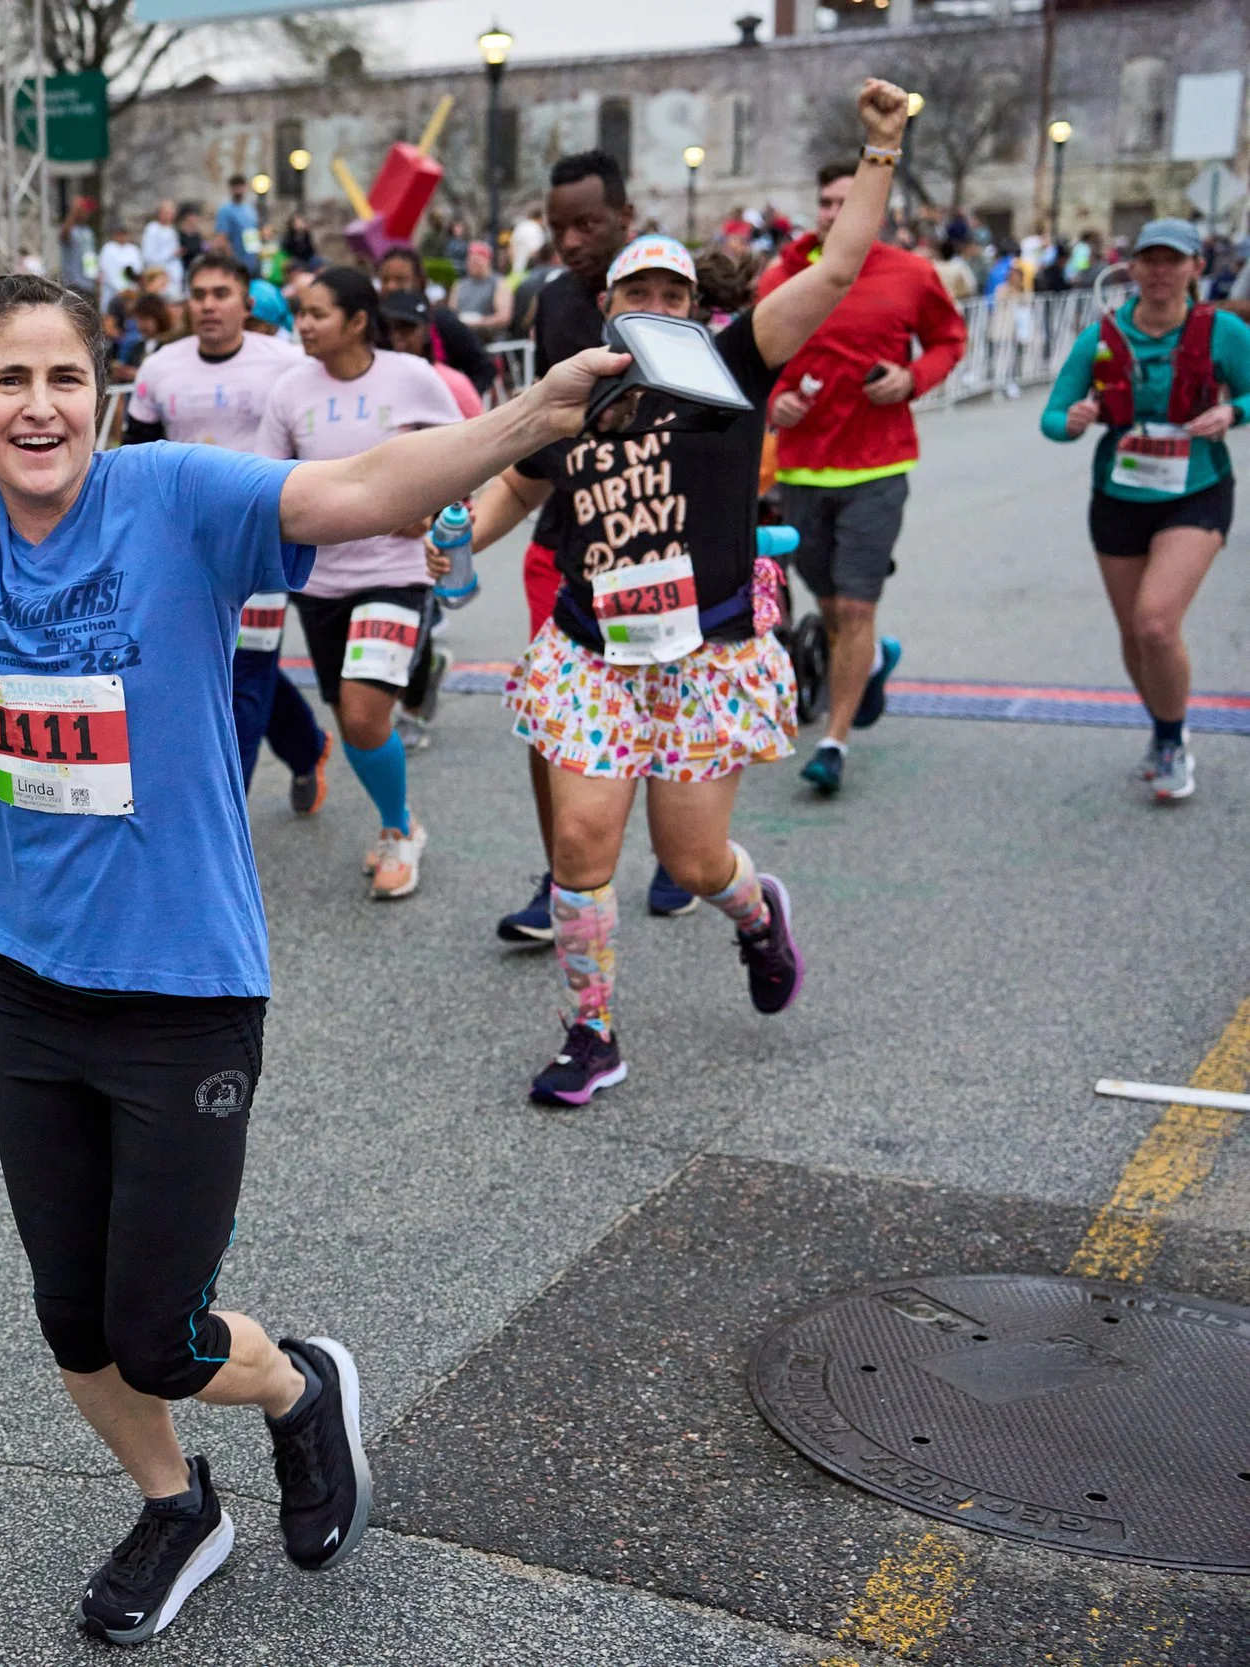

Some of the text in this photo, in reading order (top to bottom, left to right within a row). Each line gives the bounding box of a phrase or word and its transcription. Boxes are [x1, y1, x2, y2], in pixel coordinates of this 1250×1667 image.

[566, 439, 615, 475] IT'S
[574, 460, 671, 526] BIRTH
[604, 494, 687, 549] DAY!
[610, 582, 681, 616] 1239
[43, 619, 117, 641] Marathon
[357, 619, 407, 641] 1024
[79, 645, 142, 674] 26.2
[17, 779, 55, 797] Linda
[860, 1454, 1092, 1533] GEORGIA
